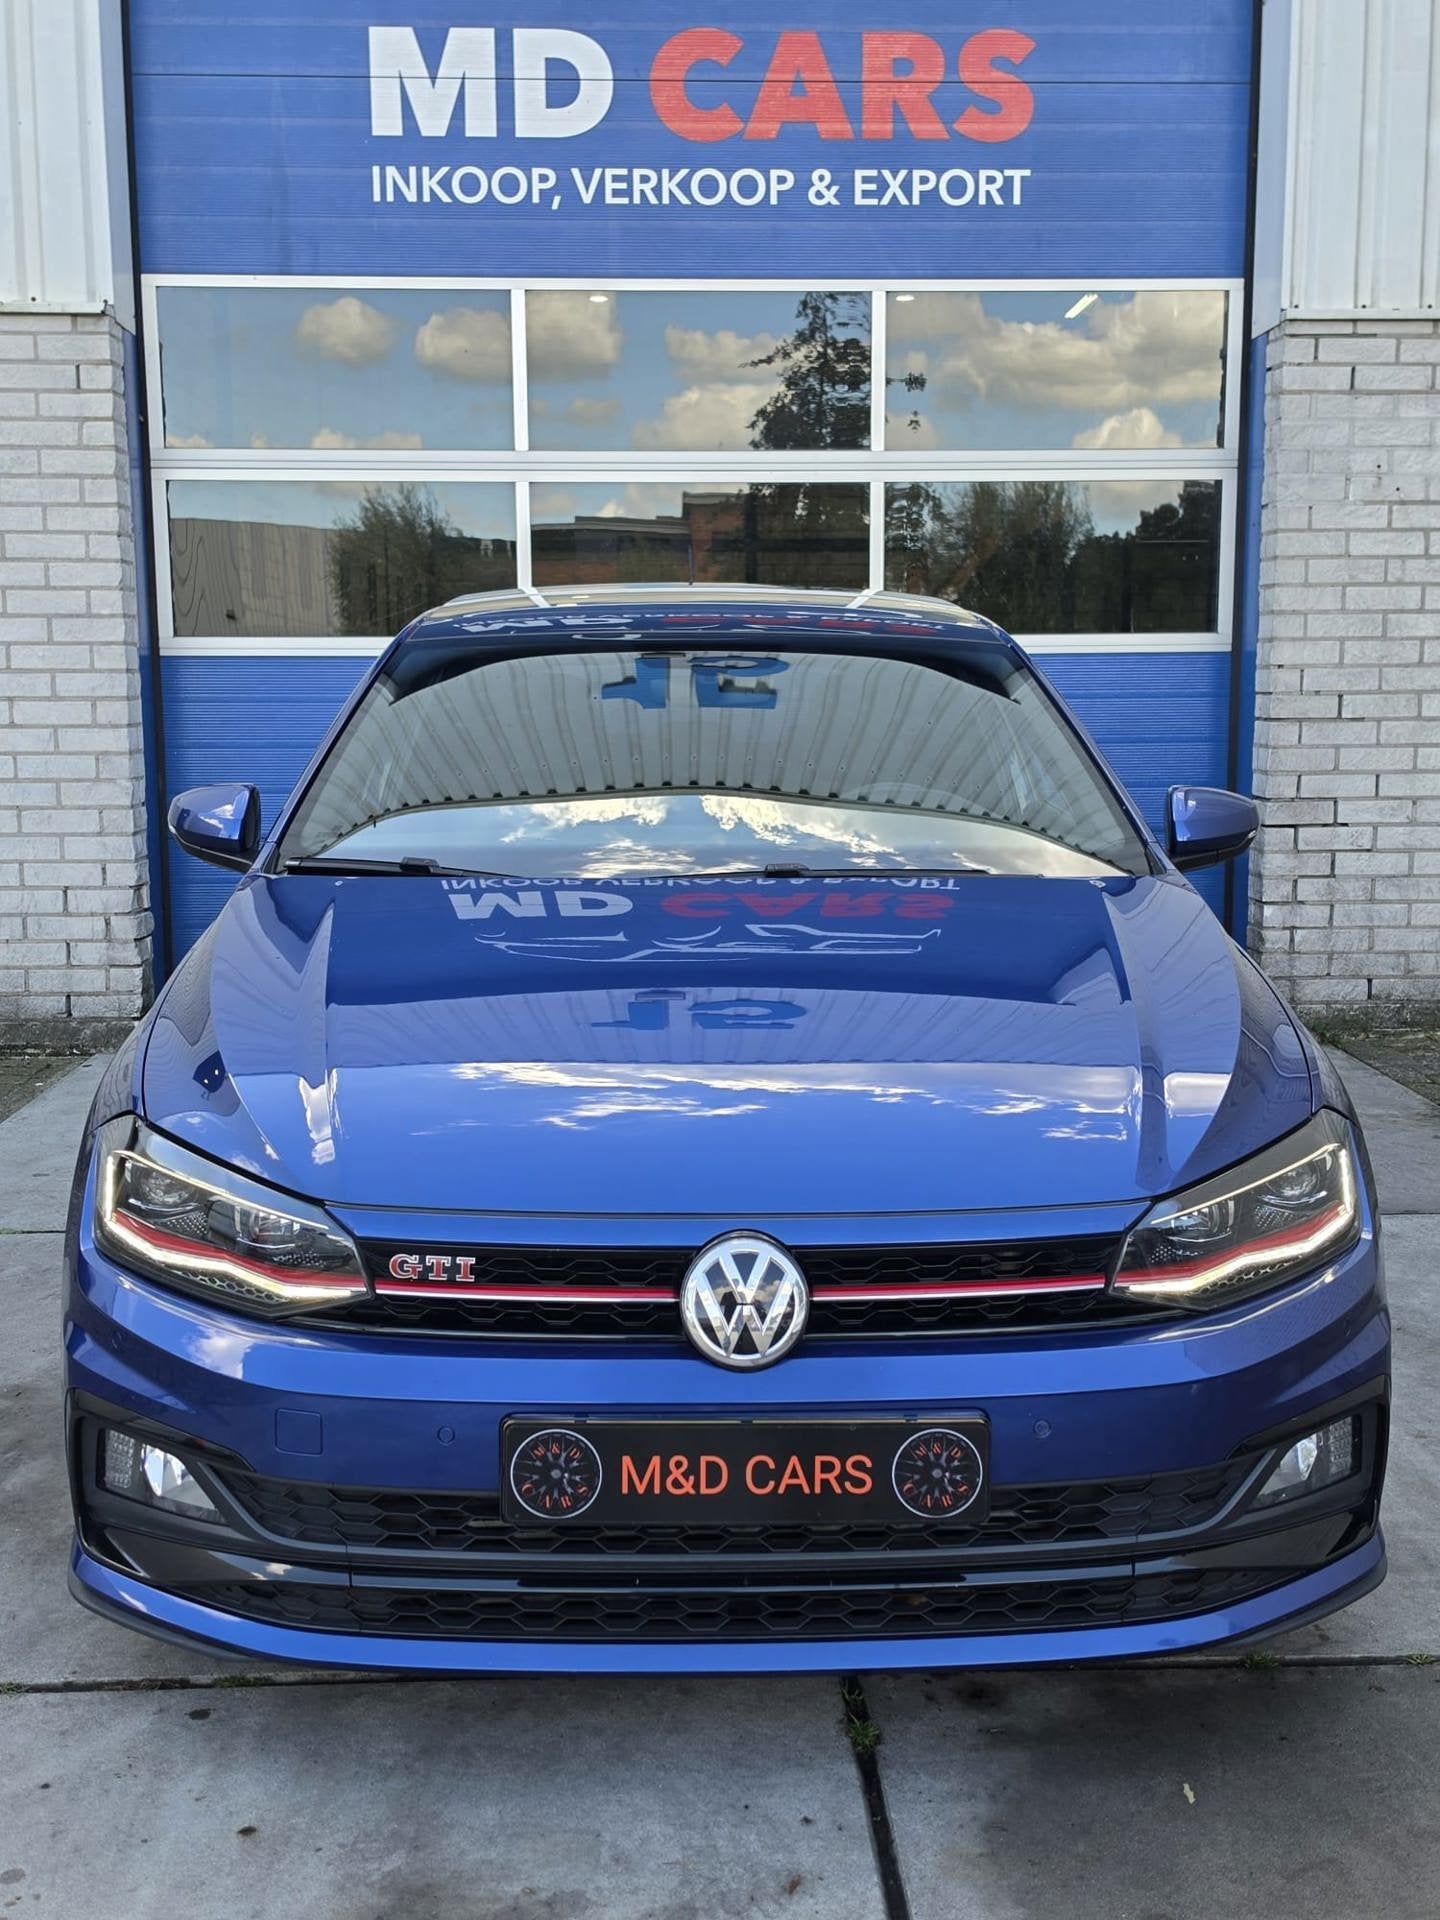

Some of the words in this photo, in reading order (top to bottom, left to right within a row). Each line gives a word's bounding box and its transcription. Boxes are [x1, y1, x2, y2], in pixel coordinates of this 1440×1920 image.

[368, 26, 614, 138] MD
[649, 26, 1037, 144] CARS
[372, 165, 562, 210] INKOOP,
[571, 167, 795, 206] VERKOOP
[808, 168, 841, 206] &
[854, 168, 1031, 206] EXPORT
[389, 1253, 475, 1282] GTI
[621, 1454, 729, 1496] M&D
[745, 1454, 873, 1496] CARS
